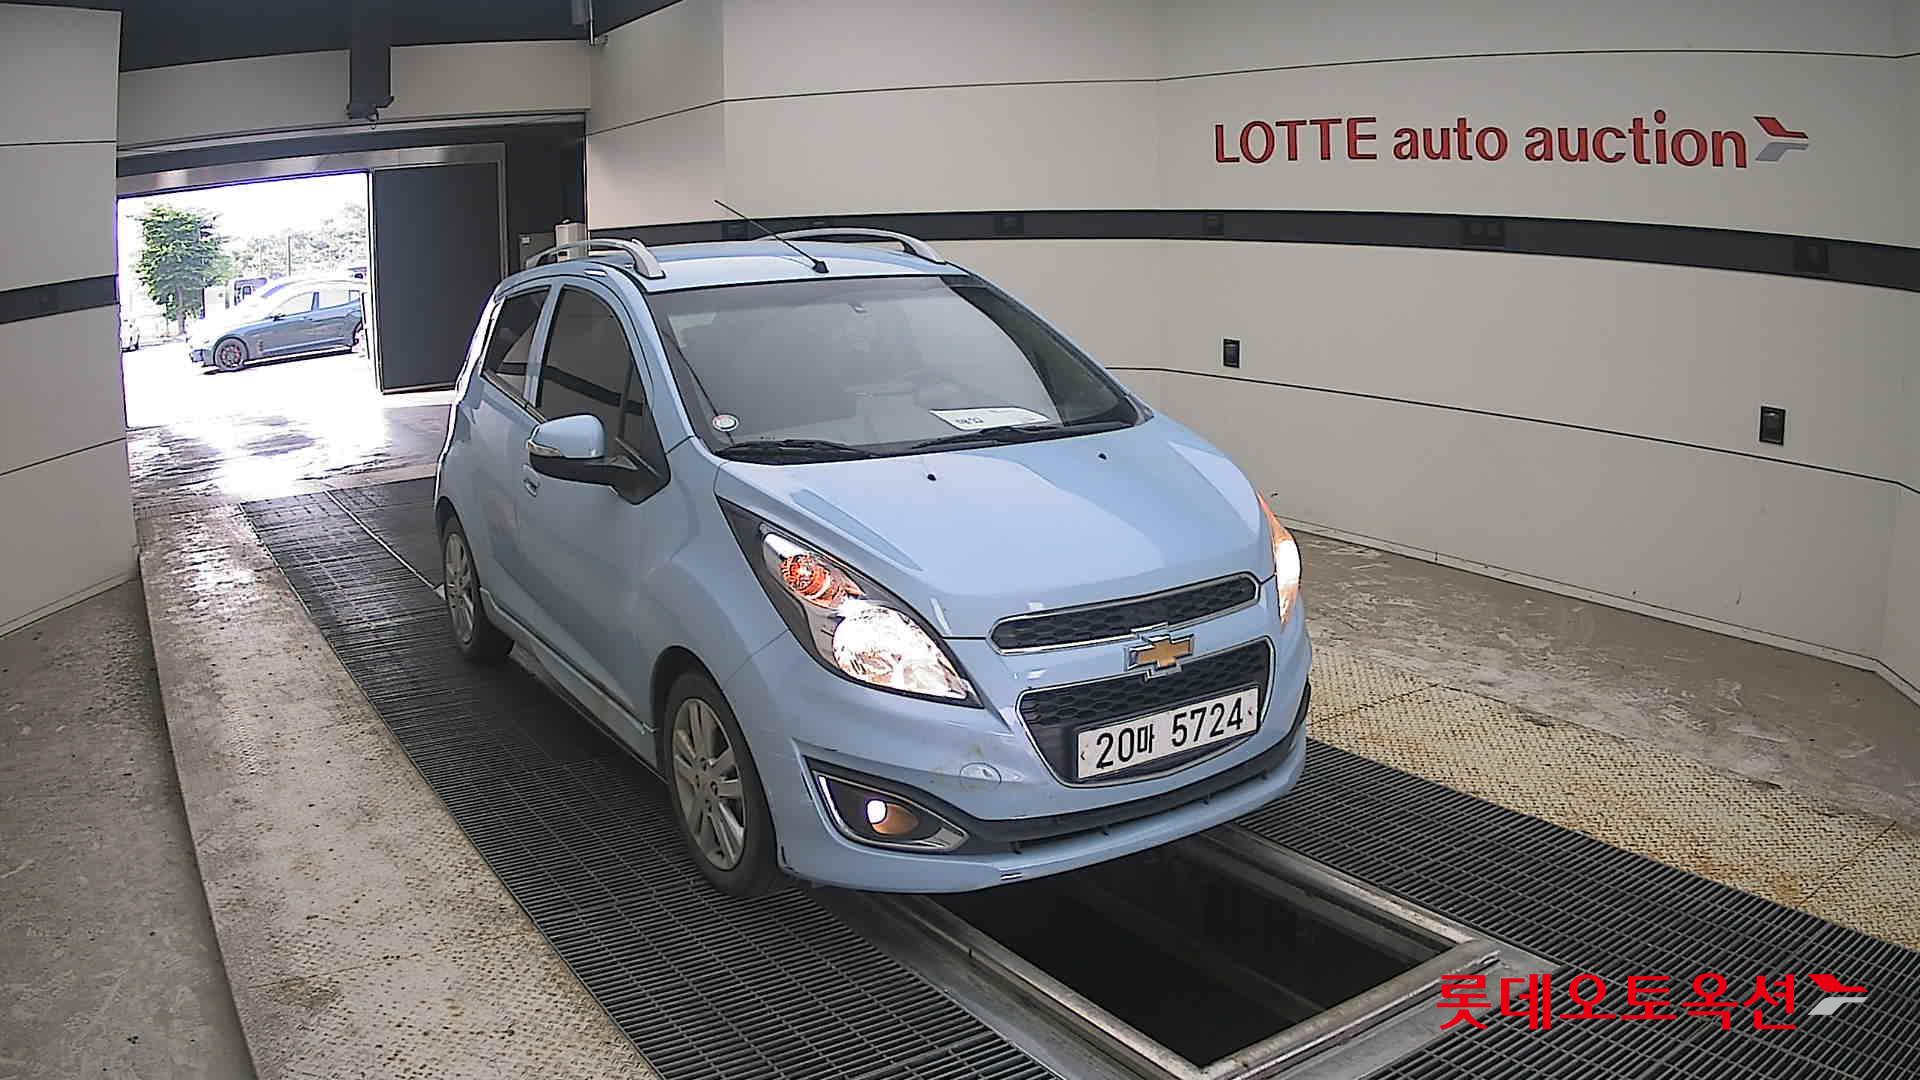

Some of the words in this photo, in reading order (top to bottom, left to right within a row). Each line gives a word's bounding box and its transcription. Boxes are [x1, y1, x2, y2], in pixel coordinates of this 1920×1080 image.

[1214, 116, 1378, 164] LOTTE
[1392, 118, 1509, 162] auto
[1524, 109, 1748, 169] auction
[1096, 724, 1155, 769] 20마
[1171, 697, 1243, 747] 5724
